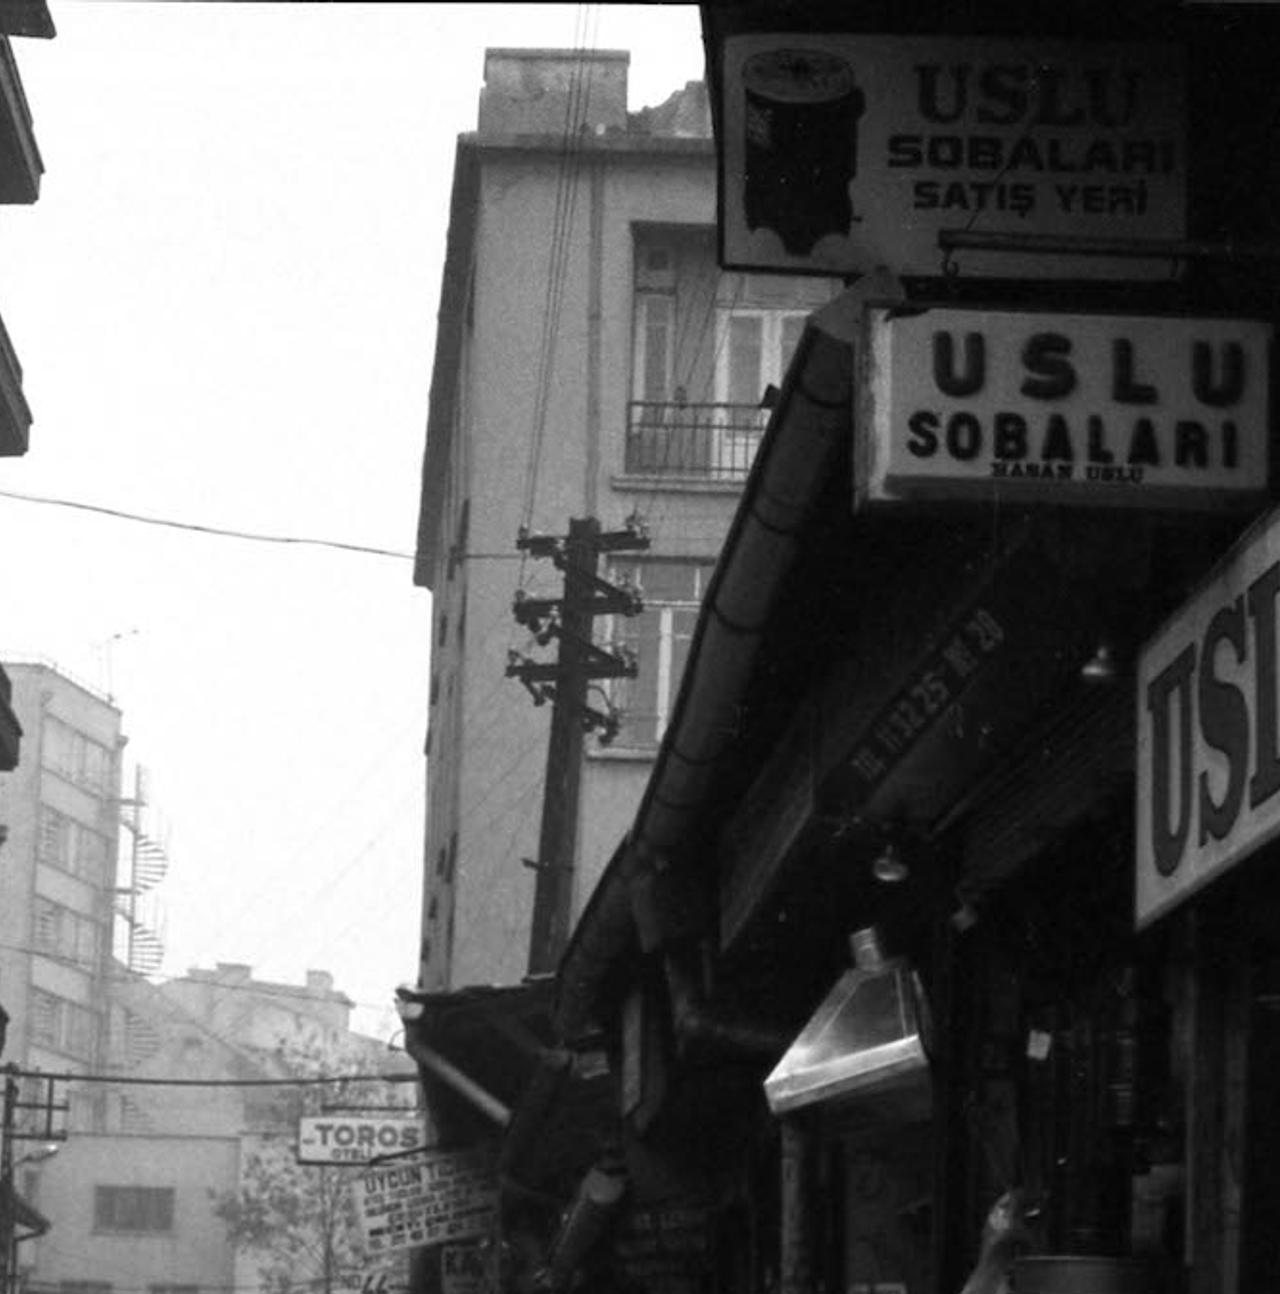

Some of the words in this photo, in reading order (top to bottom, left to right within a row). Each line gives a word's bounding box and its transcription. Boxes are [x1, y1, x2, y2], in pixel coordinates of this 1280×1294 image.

[912, 63, 1142, 126] USLU
[886, 134, 1177, 174] SOBALARI
[913, 181, 1035, 217] SATIŞ
[932, 330, 1245, 406] USLU
[906, 410, 1238, 469] SOBALARI
[991, 462, 1073, 481] HASAN
[1084, 464, 1144, 484] USLU
[314, 1123, 421, 1148] TOROS
